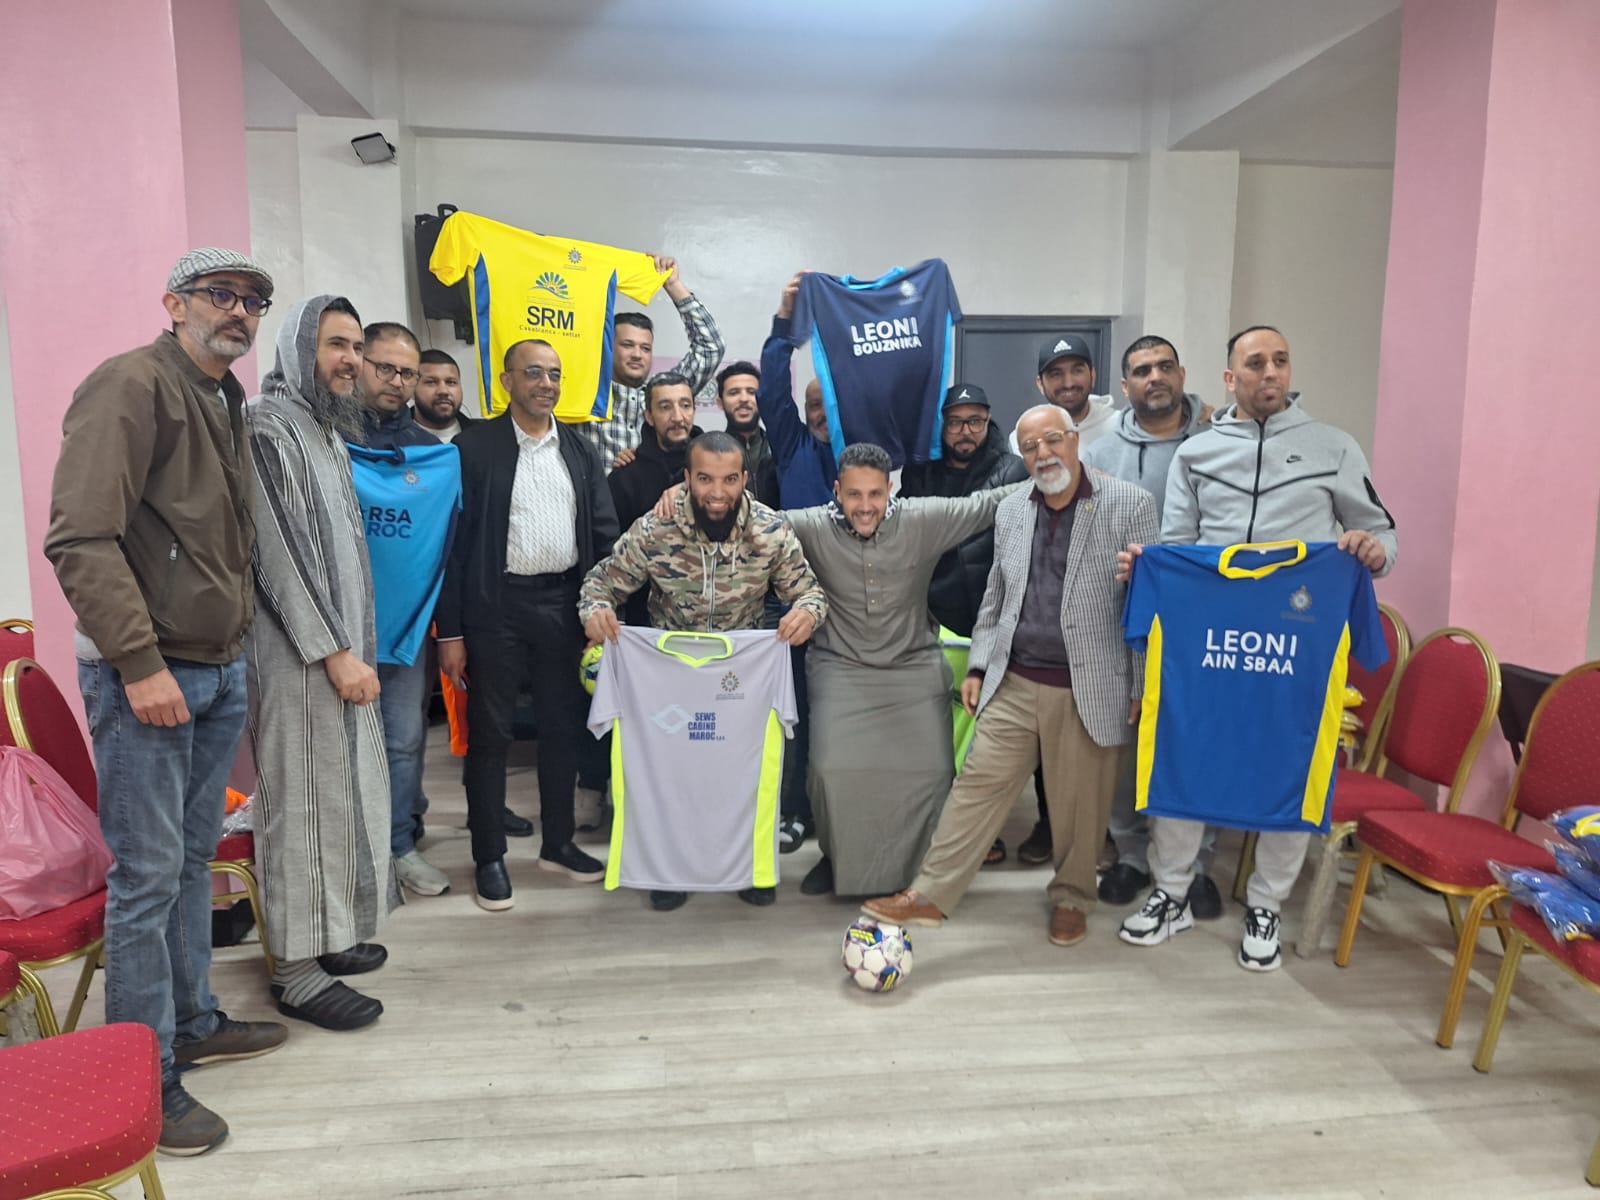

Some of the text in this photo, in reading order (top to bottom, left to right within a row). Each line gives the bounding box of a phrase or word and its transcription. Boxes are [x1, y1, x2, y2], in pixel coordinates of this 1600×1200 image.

[526, 305, 575, 331] SRM
[850, 317, 919, 343] LEONI
[852, 336, 922, 357] BOUZNIKA
[360, 503, 413, 524] RSA
[366, 521, 412, 539] ROC
[1205, 628, 1298, 657] LEONI
[1201, 653, 1294, 676] AIN SBAA
[694, 711, 716, 721] SEWS
[688, 731, 716, 741] MAROC
